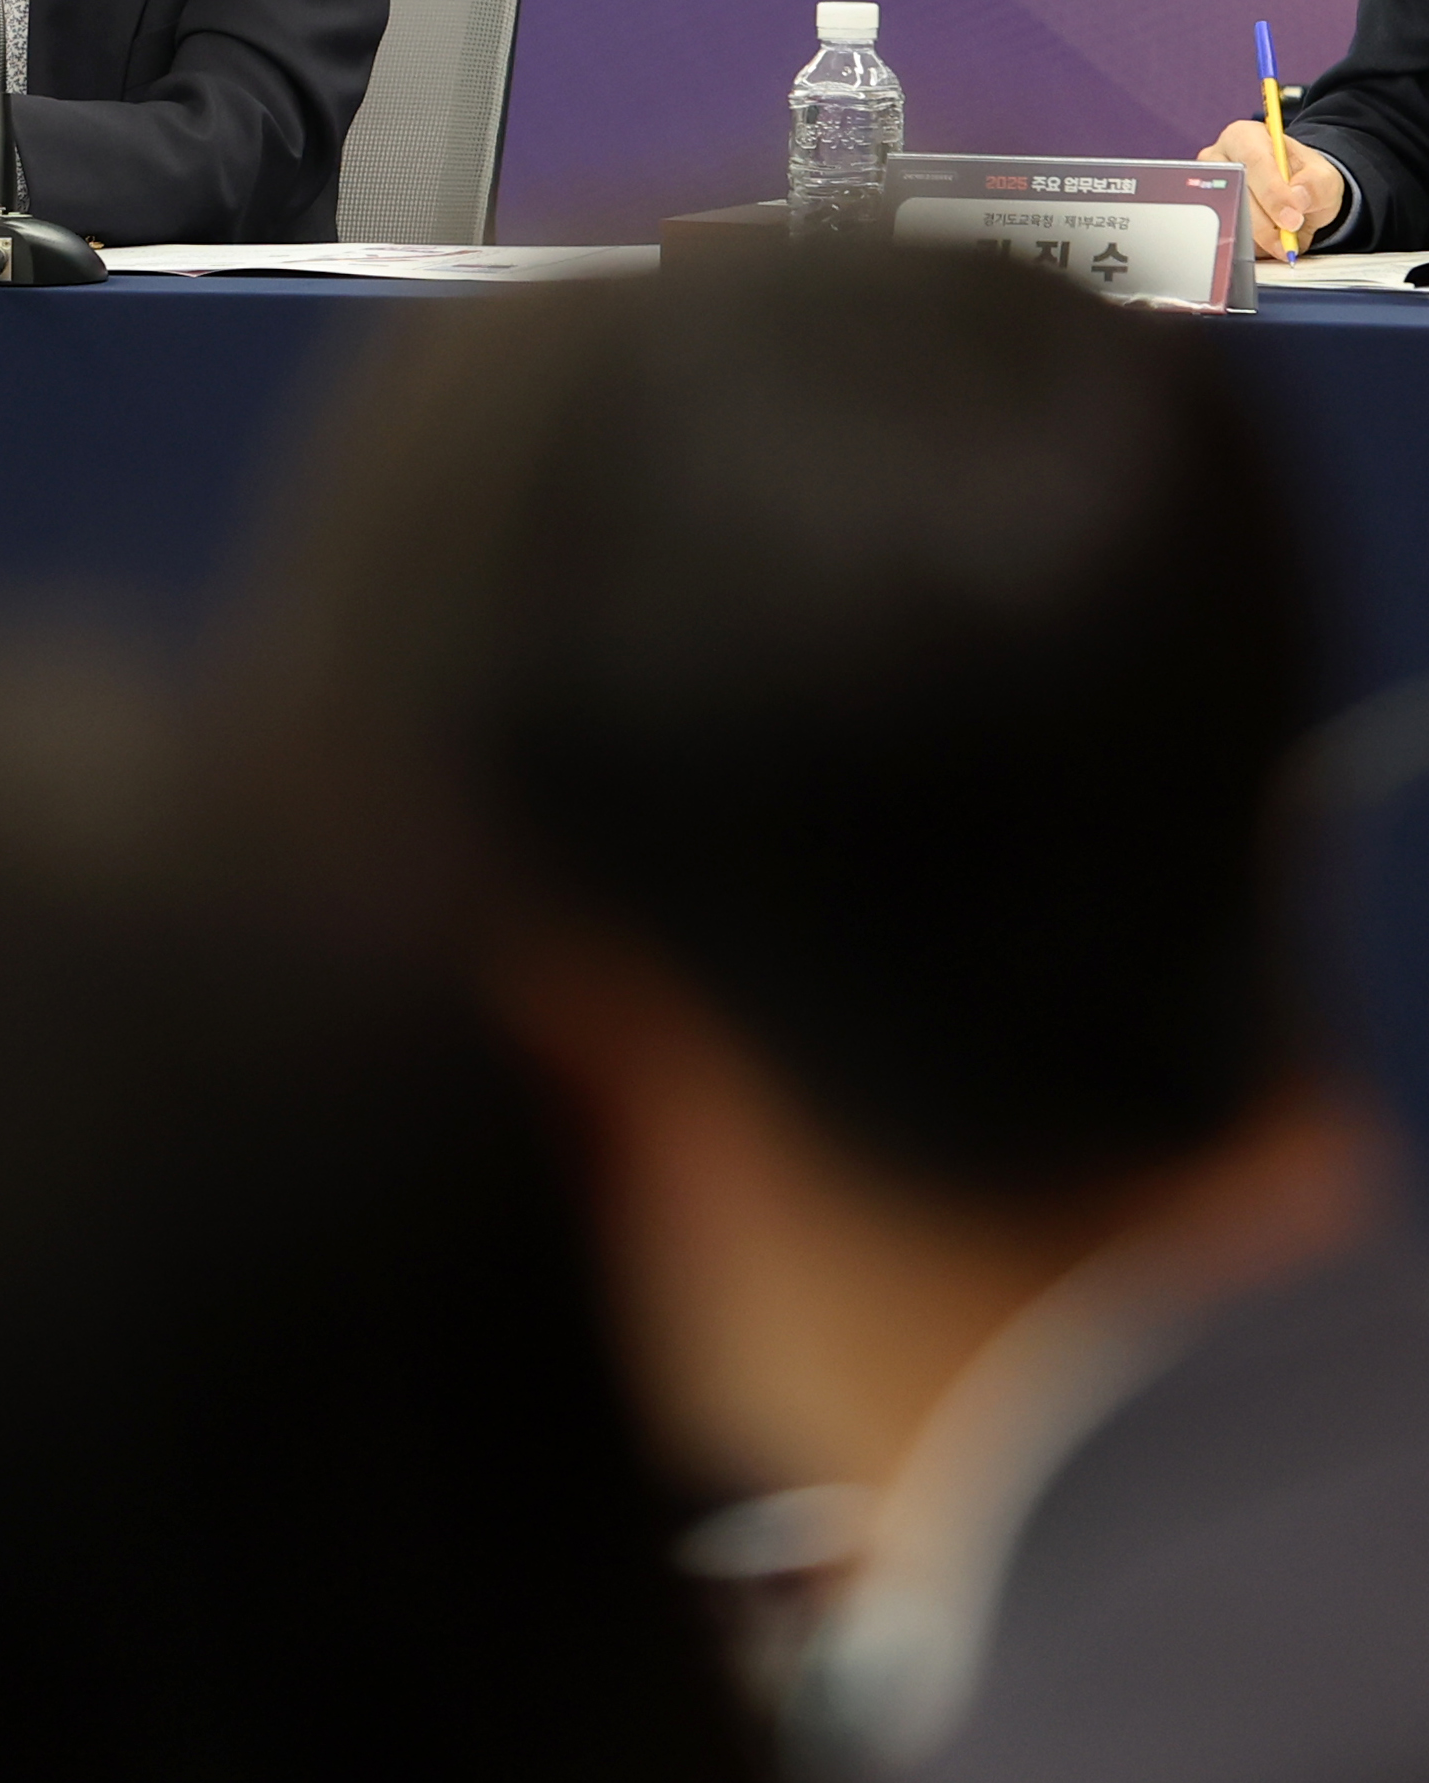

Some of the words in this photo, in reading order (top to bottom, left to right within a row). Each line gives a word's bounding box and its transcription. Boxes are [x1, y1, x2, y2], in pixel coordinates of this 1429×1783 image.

[986, 175, 1029, 191] 2025
[1031, 176, 1061, 193] 주요
[1064, 177, 1137, 195] 업무보고회
